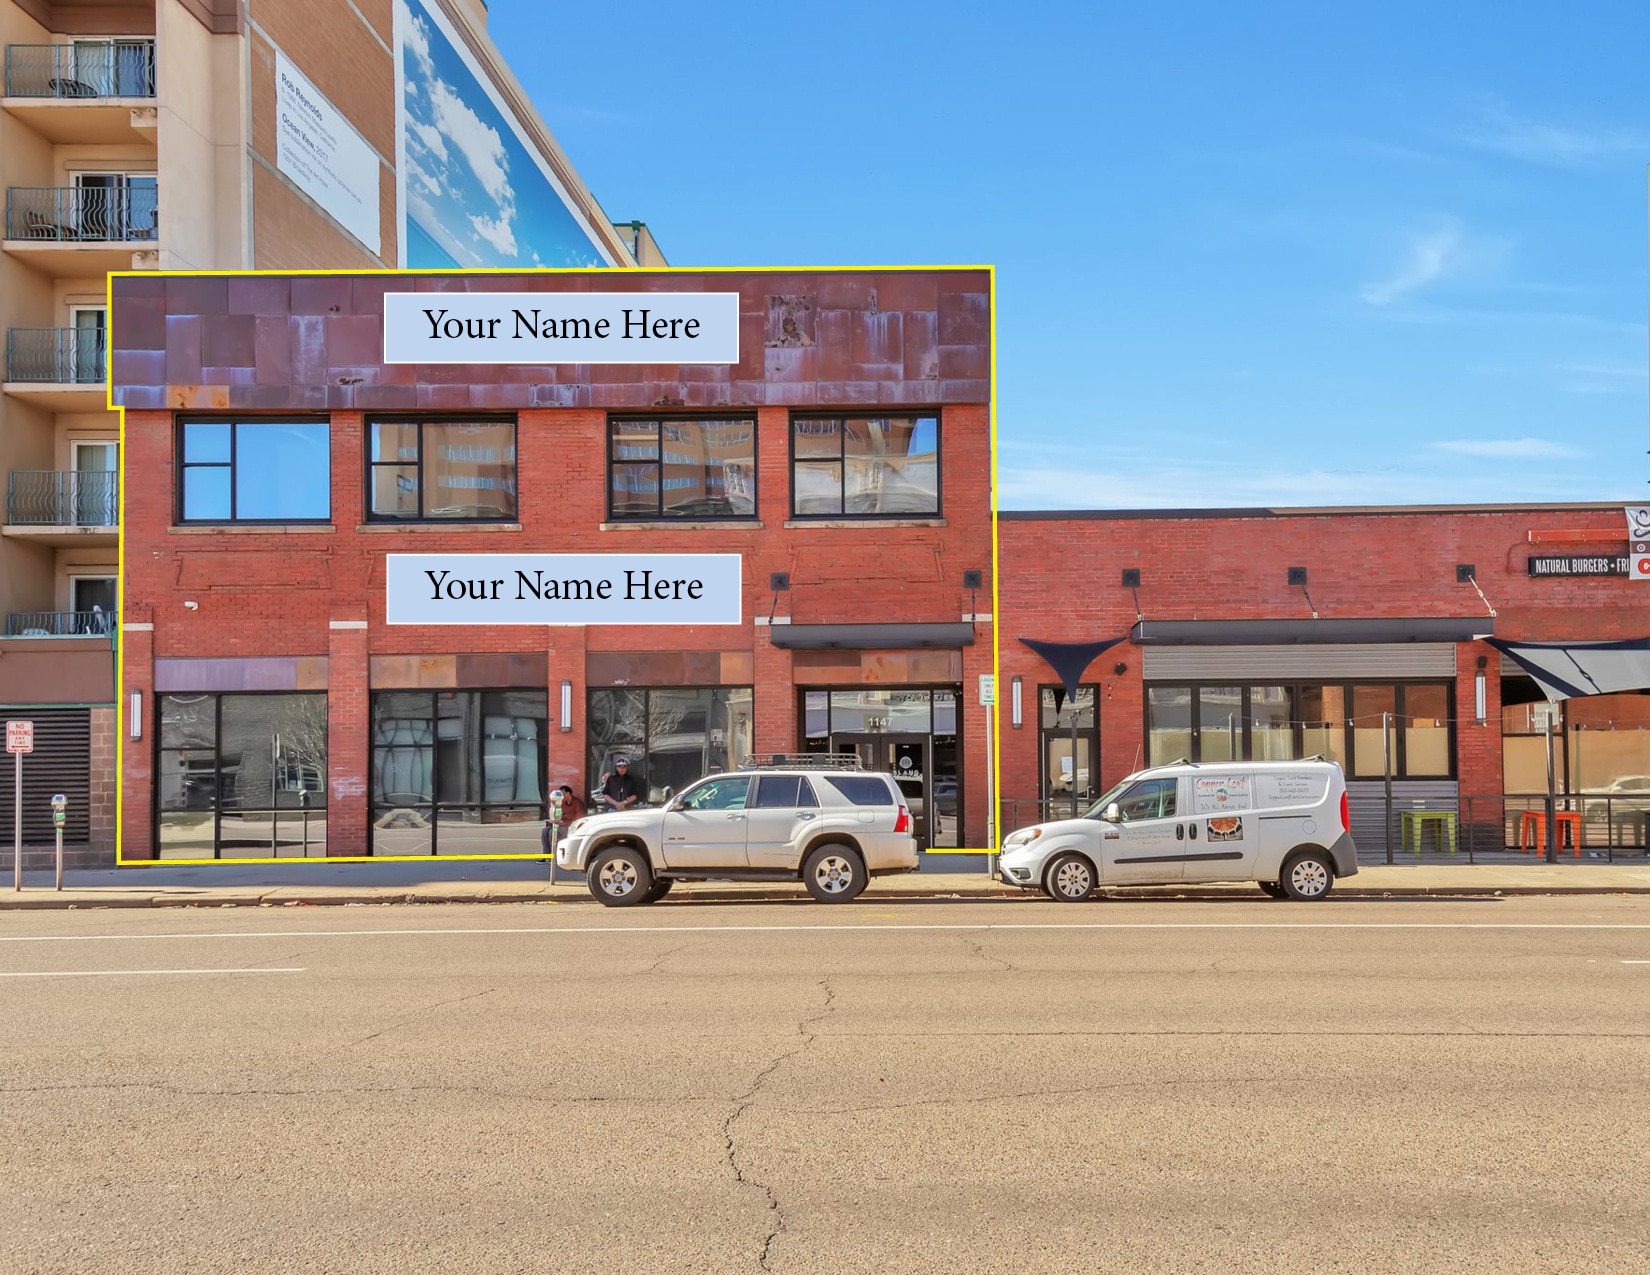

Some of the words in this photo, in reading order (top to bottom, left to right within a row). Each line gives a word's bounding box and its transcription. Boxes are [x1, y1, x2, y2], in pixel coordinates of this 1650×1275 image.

[282, 72, 294, 92] Rob
[296, 87, 322, 121] Reynolds
[282, 112, 300, 136] Ocean
[301, 130, 316, 151] View,
[316, 145, 328, 162] 2017
[282, 141, 300, 164] Collection
[1535, 559, 1570, 573] NATURAL
[1572, 558, 1609, 573] BURGERS
[1616, 557, 1630, 572] FRI
[868, 717, 893, 726] 1147
[1196, 779, 1224, 792] Copper
[1226, 776, 1247, 789] Leaf
